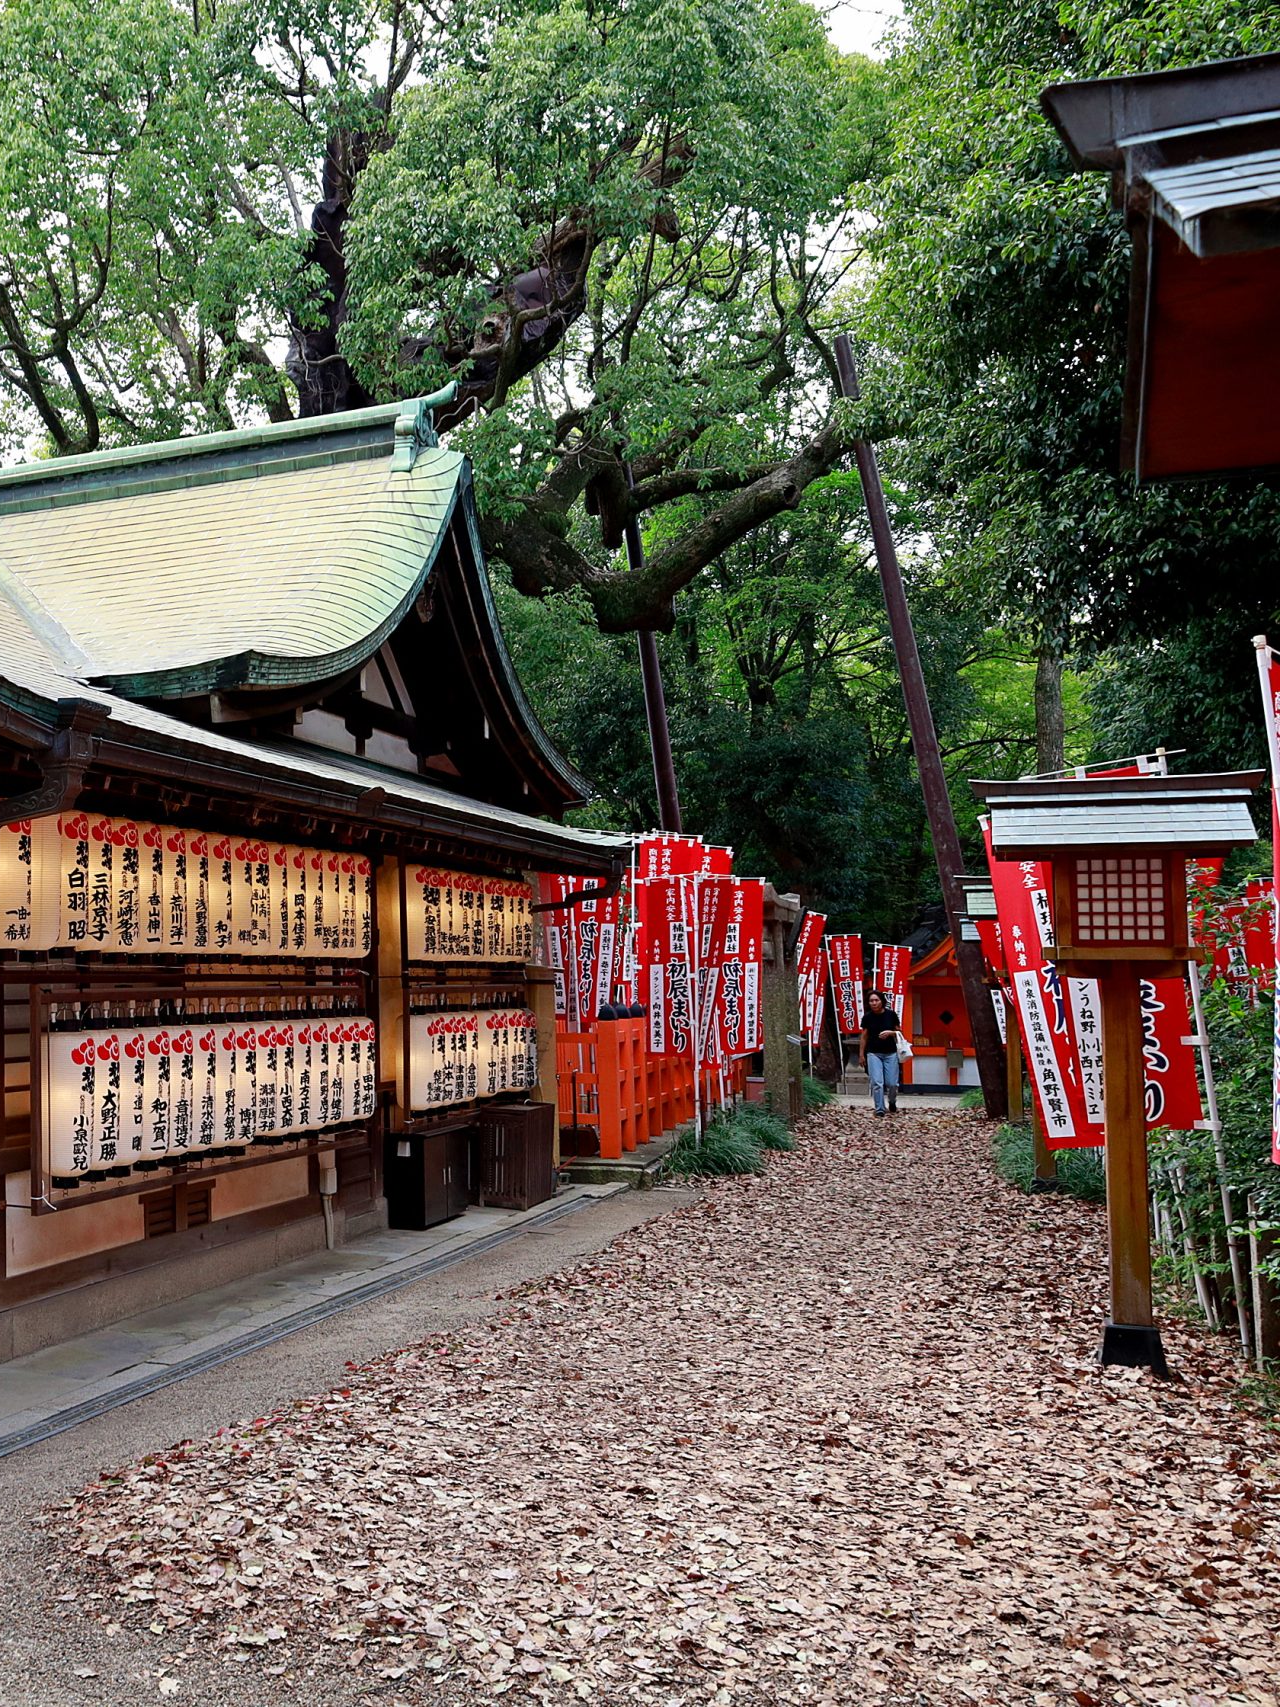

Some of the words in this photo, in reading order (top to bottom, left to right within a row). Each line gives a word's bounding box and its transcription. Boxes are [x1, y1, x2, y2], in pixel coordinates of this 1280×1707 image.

[88, 872, 110, 942] 三林京子
[146, 892, 162, 944] 香山伸一
[169, 894, 185, 946] 荒川洋一
[292, 893, 306, 950] 岡本佳幸
[665, 888, 676, 922] 家内安全
[1012, 925, 1027, 967] 奉納者
[666, 957, 691, 1054] 初辰まいり
[98, 1088, 118, 1162] 大野正勝
[280, 1083, 293, 1129] 小西大助
[298, 1068, 311, 1125] 南方正良
[1042, 1067, 1068, 1129] 角野賢市
